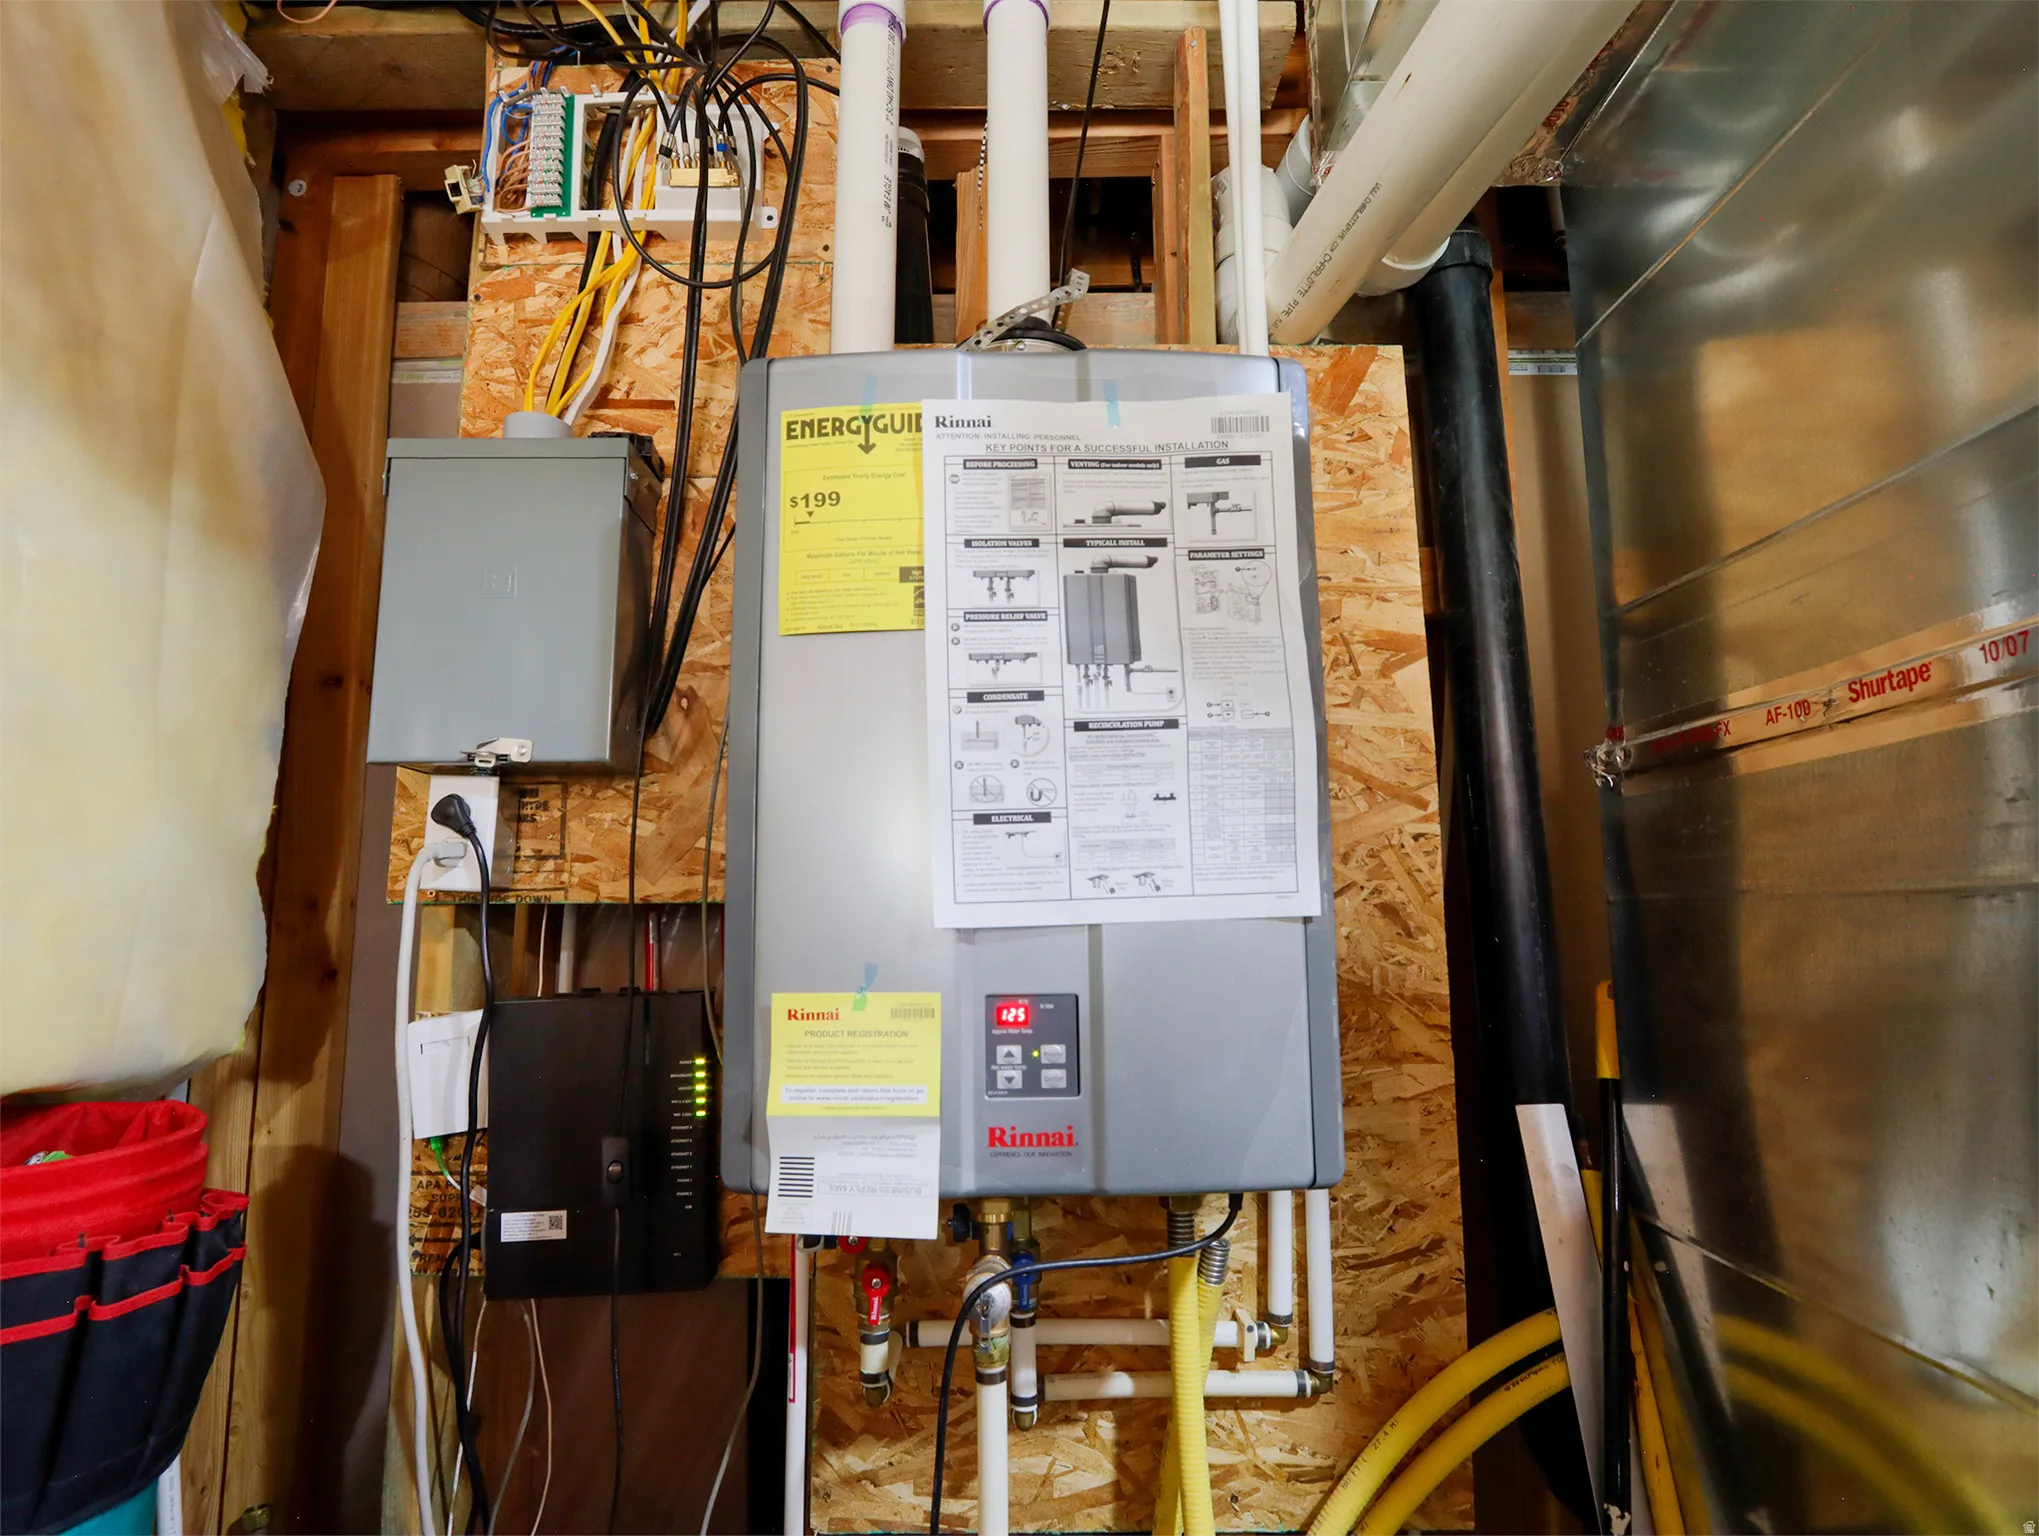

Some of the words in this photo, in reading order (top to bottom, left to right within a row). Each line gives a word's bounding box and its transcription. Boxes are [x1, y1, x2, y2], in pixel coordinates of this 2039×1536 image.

[884, 175, 892, 200] EAGLE
[1296, 252, 1333, 298] CHARLOTTE
[1281, 298, 1300, 318] PIPE
[935, 415, 992, 429] Rinnai
[986, 444, 1007, 452] KEY
[1010, 444, 1047, 452] POINTS
[1084, 444, 1150, 453] SUCCESSFUL
[1155, 441, 1229, 451] INSTALLATION
[966, 460, 991, 468] BEFORE
[993, 460, 1035, 468] PROCEEDING
[1070, 460, 1100, 468] VENTING
[1216, 457, 1230, 465] GAS
[789, 491, 841, 509] $199
[1189, 551, 1230, 560] PARAMETER
[1231, 550, 1263, 558] SETTINGS
[983, 692, 1029, 701] CONDENSATE
[1765, 699, 1811, 727] AF-100
[1848, 663, 1930, 702] Shurtape
[1088, 721, 1143, 729] RECIRCULATION
[1144, 720, 1165, 728] PUMP
[991, 814, 1034, 823] ELECTRICAL
[516, 894, 551, 902] DOWN
[787, 1008, 840, 1021] Rinnai
[1002, 1007, 1026, 1022] 125
[805, 1030, 844, 1038] PRODUCT
[848, 1030, 908, 1038] REGISTRATION
[987, 1125, 1075, 1148] Rinnai
[849, 1184, 877, 1194] REPLY
[878, 1184, 922, 1196] BUSINESS
